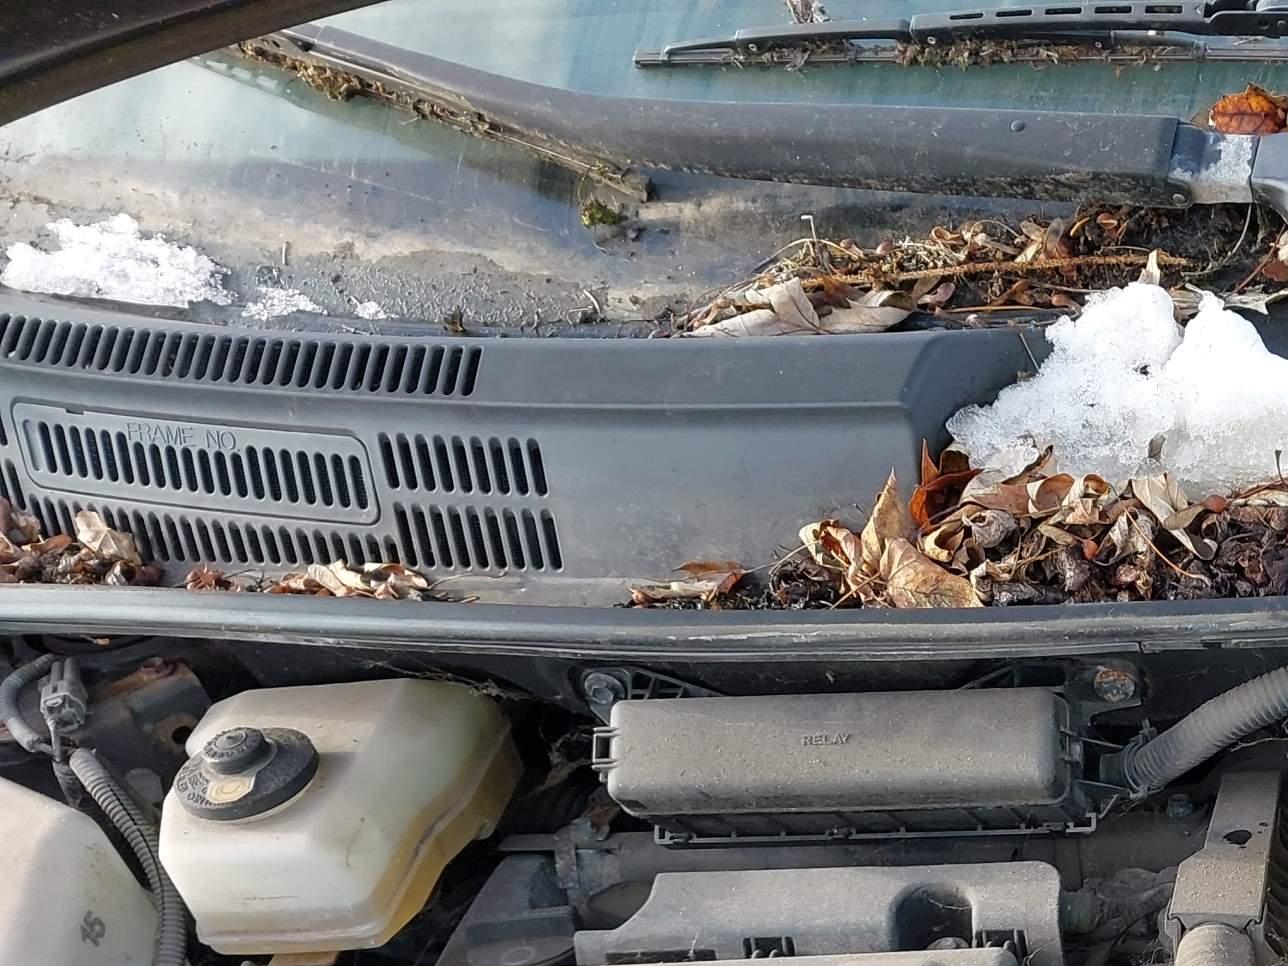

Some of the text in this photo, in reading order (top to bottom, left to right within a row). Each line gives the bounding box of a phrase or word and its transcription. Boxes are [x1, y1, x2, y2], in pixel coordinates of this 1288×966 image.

[126, 422, 241, 452] FRAME NO.
[803, 733, 853, 746] RELAY
